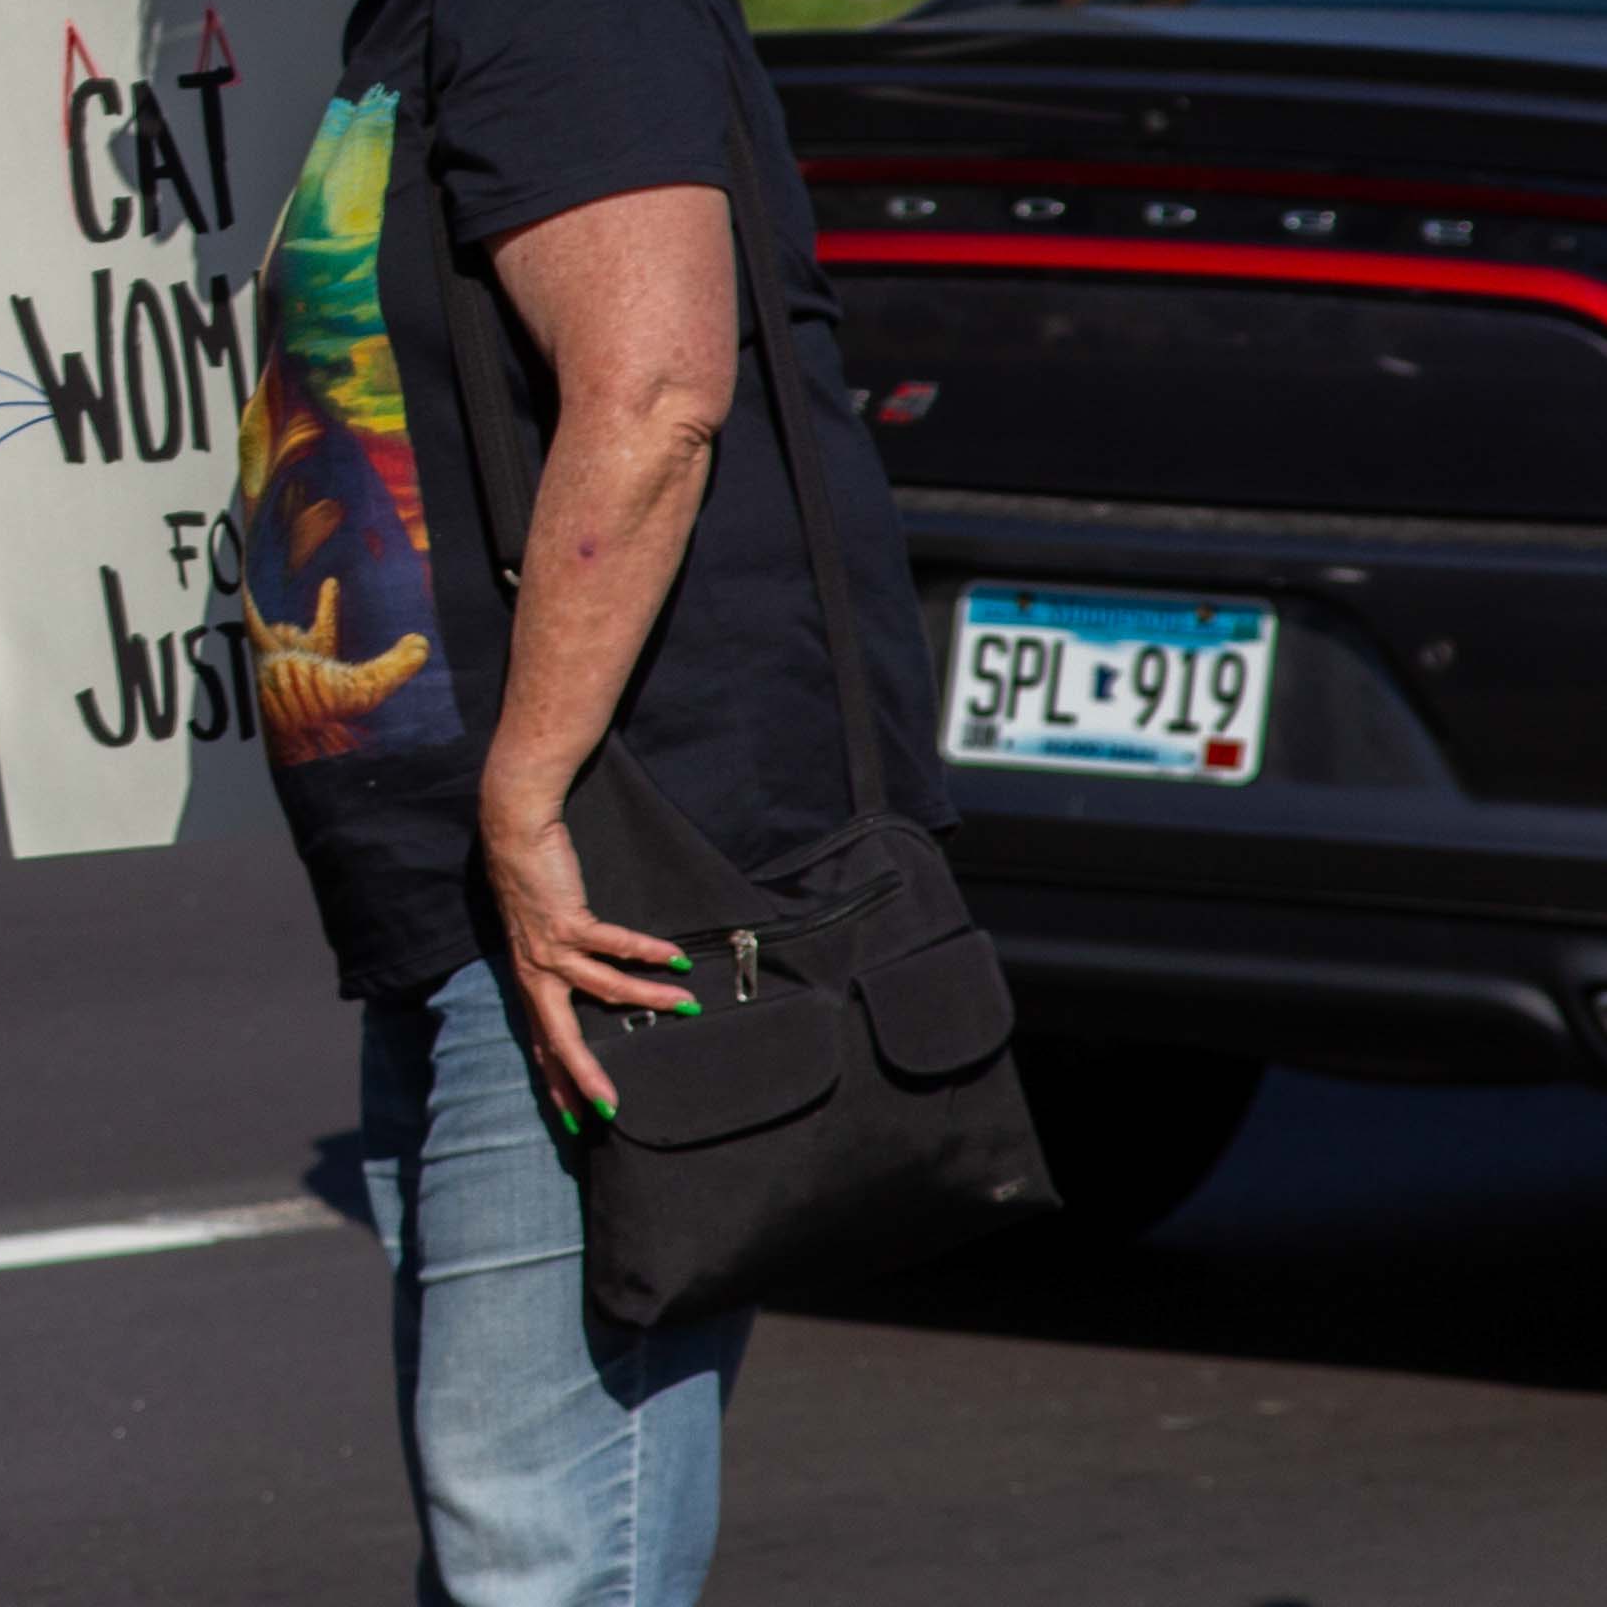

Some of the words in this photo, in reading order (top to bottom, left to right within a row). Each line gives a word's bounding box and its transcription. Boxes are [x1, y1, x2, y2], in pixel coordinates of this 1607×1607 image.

[69, 66, 235, 244] CAT
[967, 633, 1079, 725] SPL
[1130, 644, 1249, 735] 919
